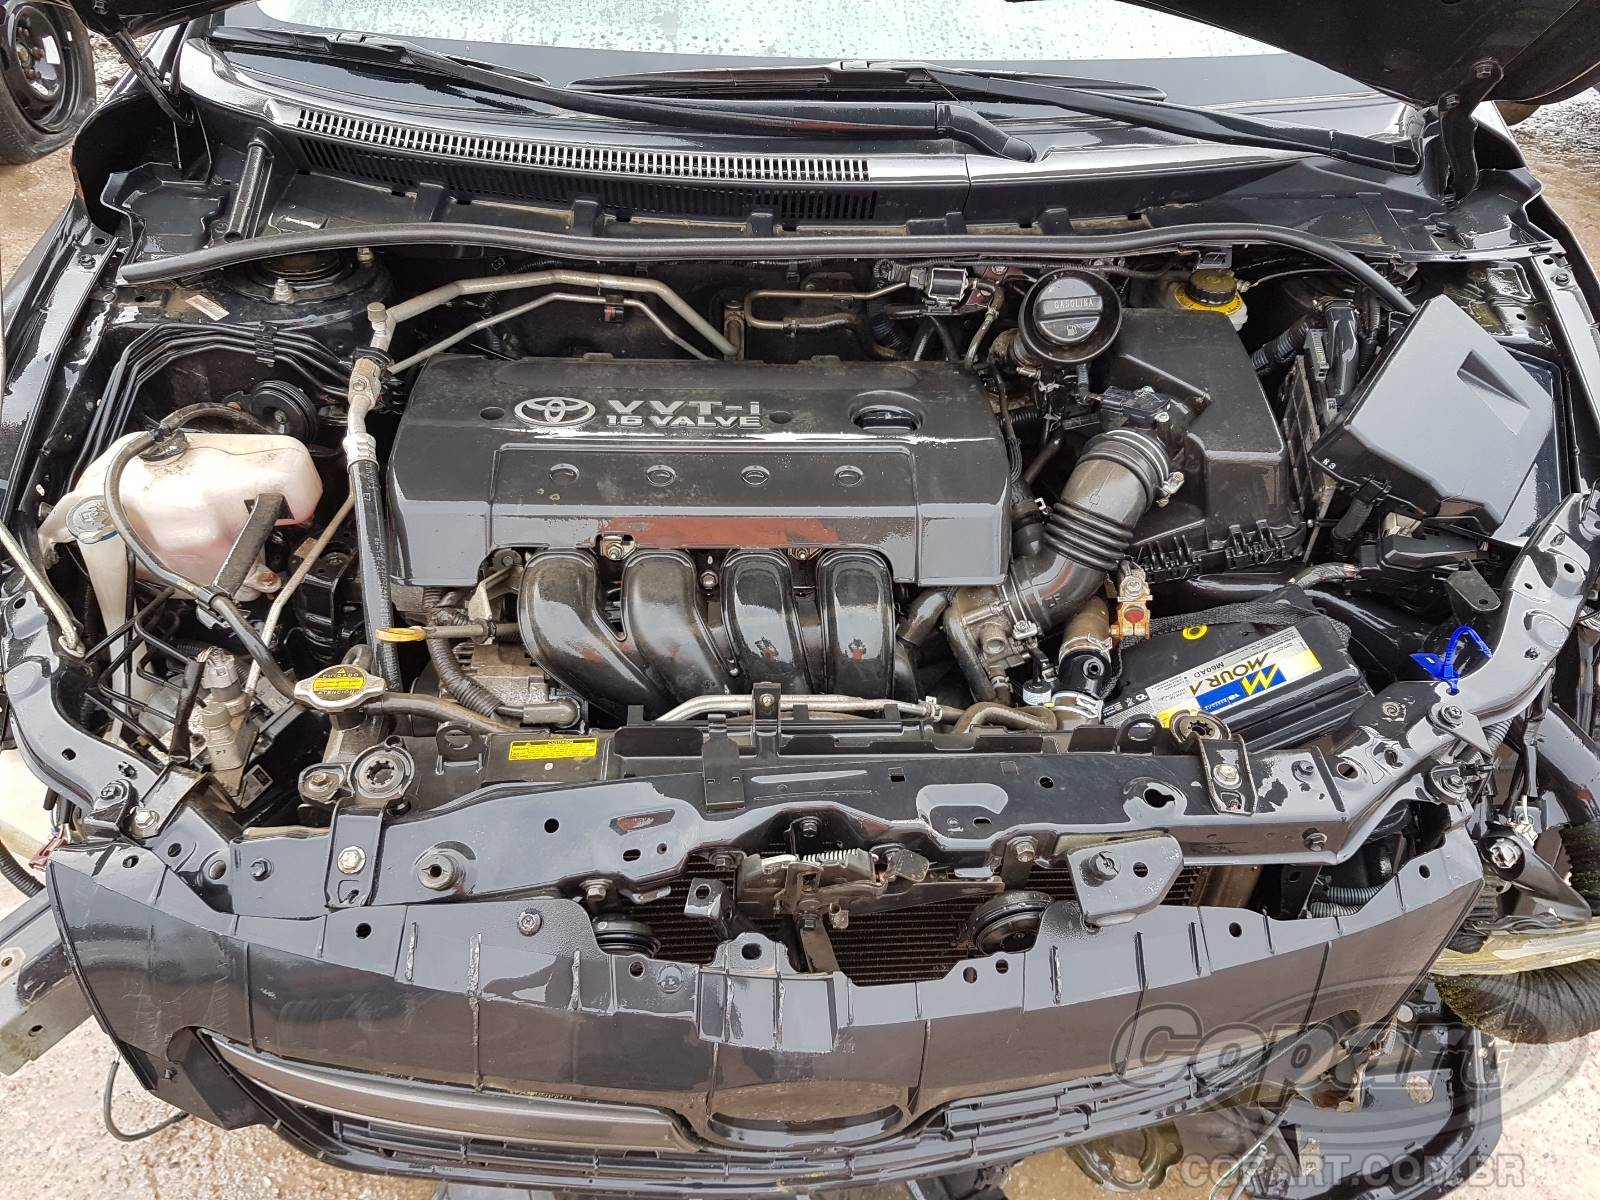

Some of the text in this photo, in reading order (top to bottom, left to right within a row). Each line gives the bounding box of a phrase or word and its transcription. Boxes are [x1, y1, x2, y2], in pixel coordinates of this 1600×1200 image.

[1054, 297, 1094, 309] GASOLINA
[605, 415, 764, 428] 16 VALVE
[1188, 652, 1270, 696] MOURA
